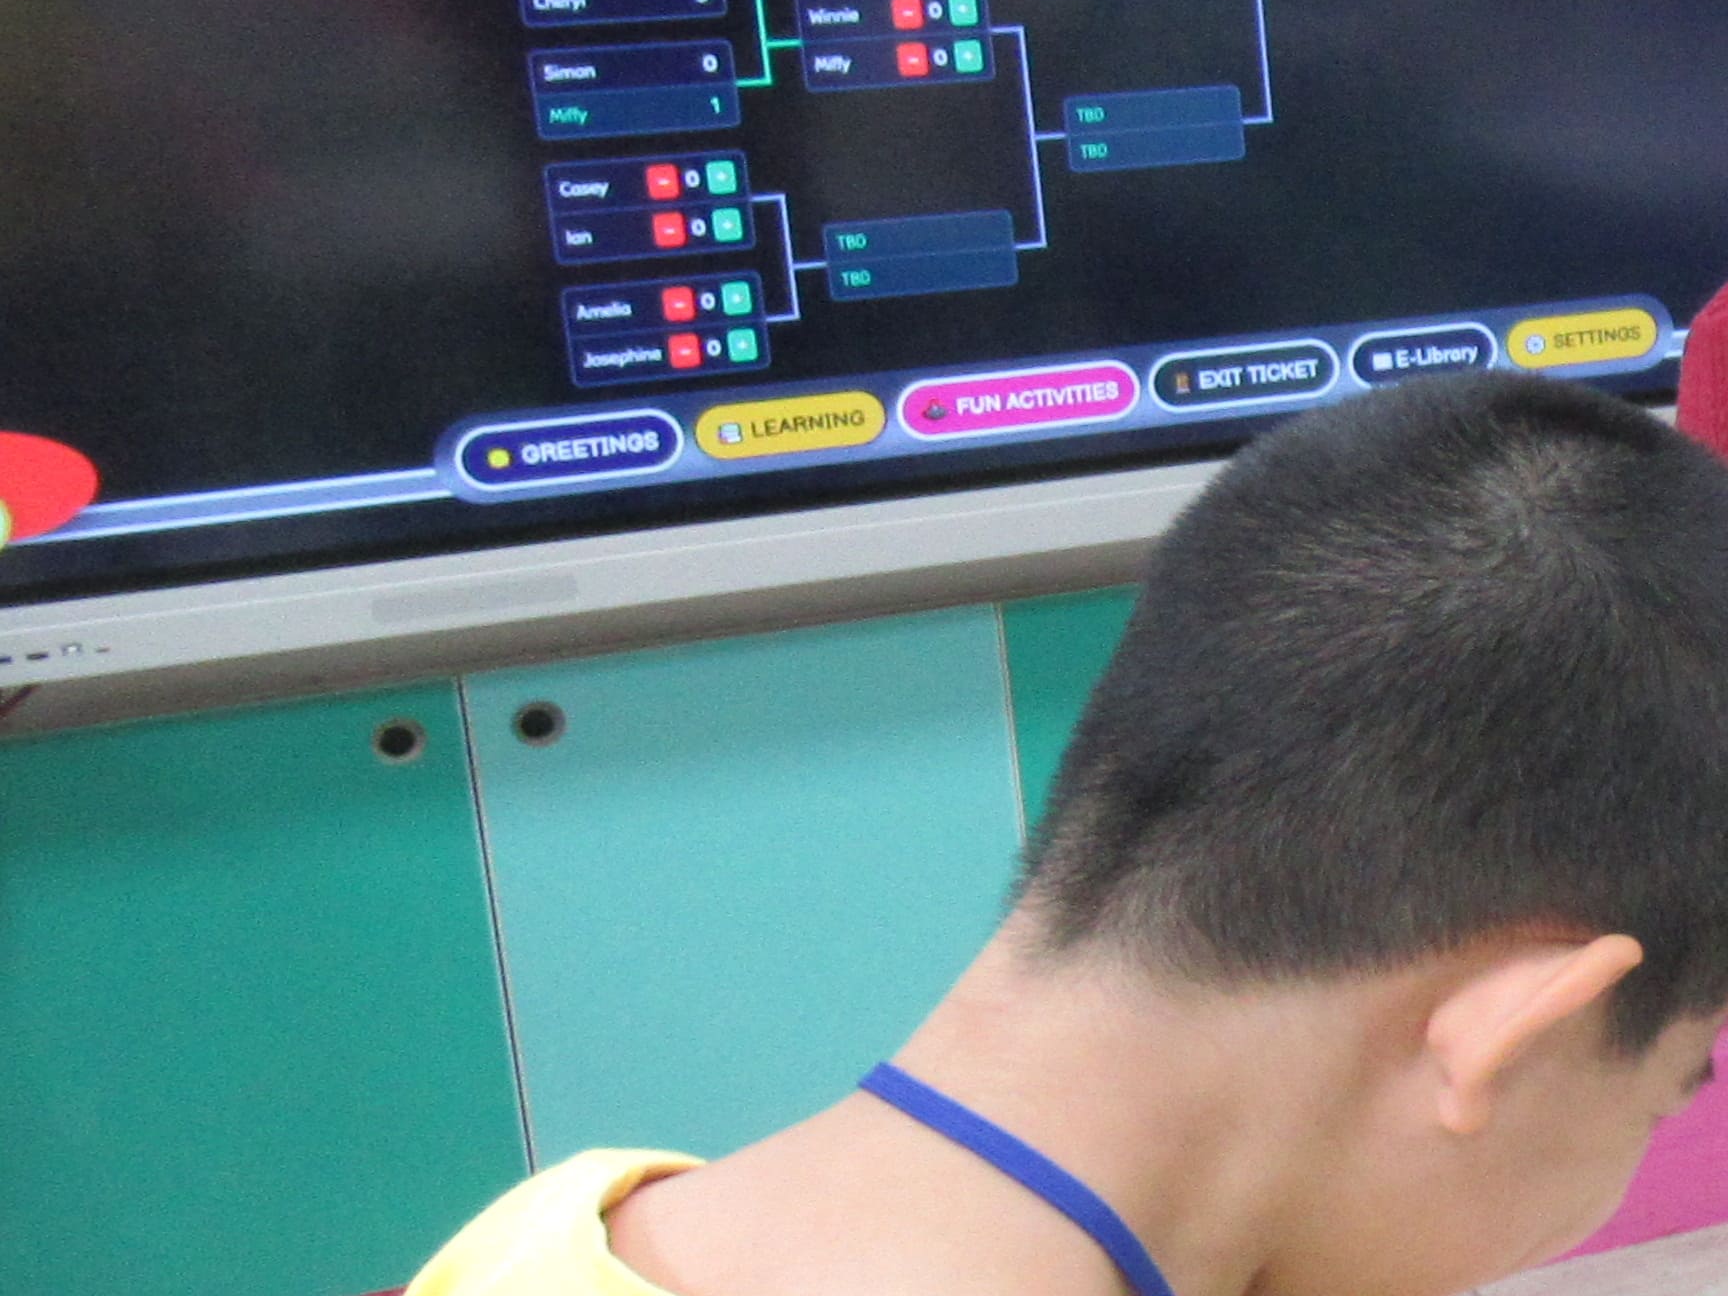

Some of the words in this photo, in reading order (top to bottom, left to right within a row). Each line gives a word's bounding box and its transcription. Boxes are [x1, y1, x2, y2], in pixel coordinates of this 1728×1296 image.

[929, 2, 942, 18] 0
[544, 64, 596, 81] Simon
[702, 54, 717, 71] 0
[933, 49, 947, 66] 0
[710, 97, 720, 113] 1
[559, 181, 610, 198] Casey
[685, 170, 699, 188] 0
[691, 218, 706, 236] 0
[701, 293, 715, 310] 0
[706, 339, 721, 356] 0
[1553, 326, 1641, 350] SETTINGS
[1395, 344, 1478, 372] E-Library
[1199, 370, 1241, 390] EXIT
[1246, 359, 1319, 385] TICKET
[956, 392, 1003, 416] FUN
[1007, 379, 1119, 411] ACTIVITIES
[750, 409, 865, 438] LEARNING
[521, 431, 659, 466] GREETINGS
